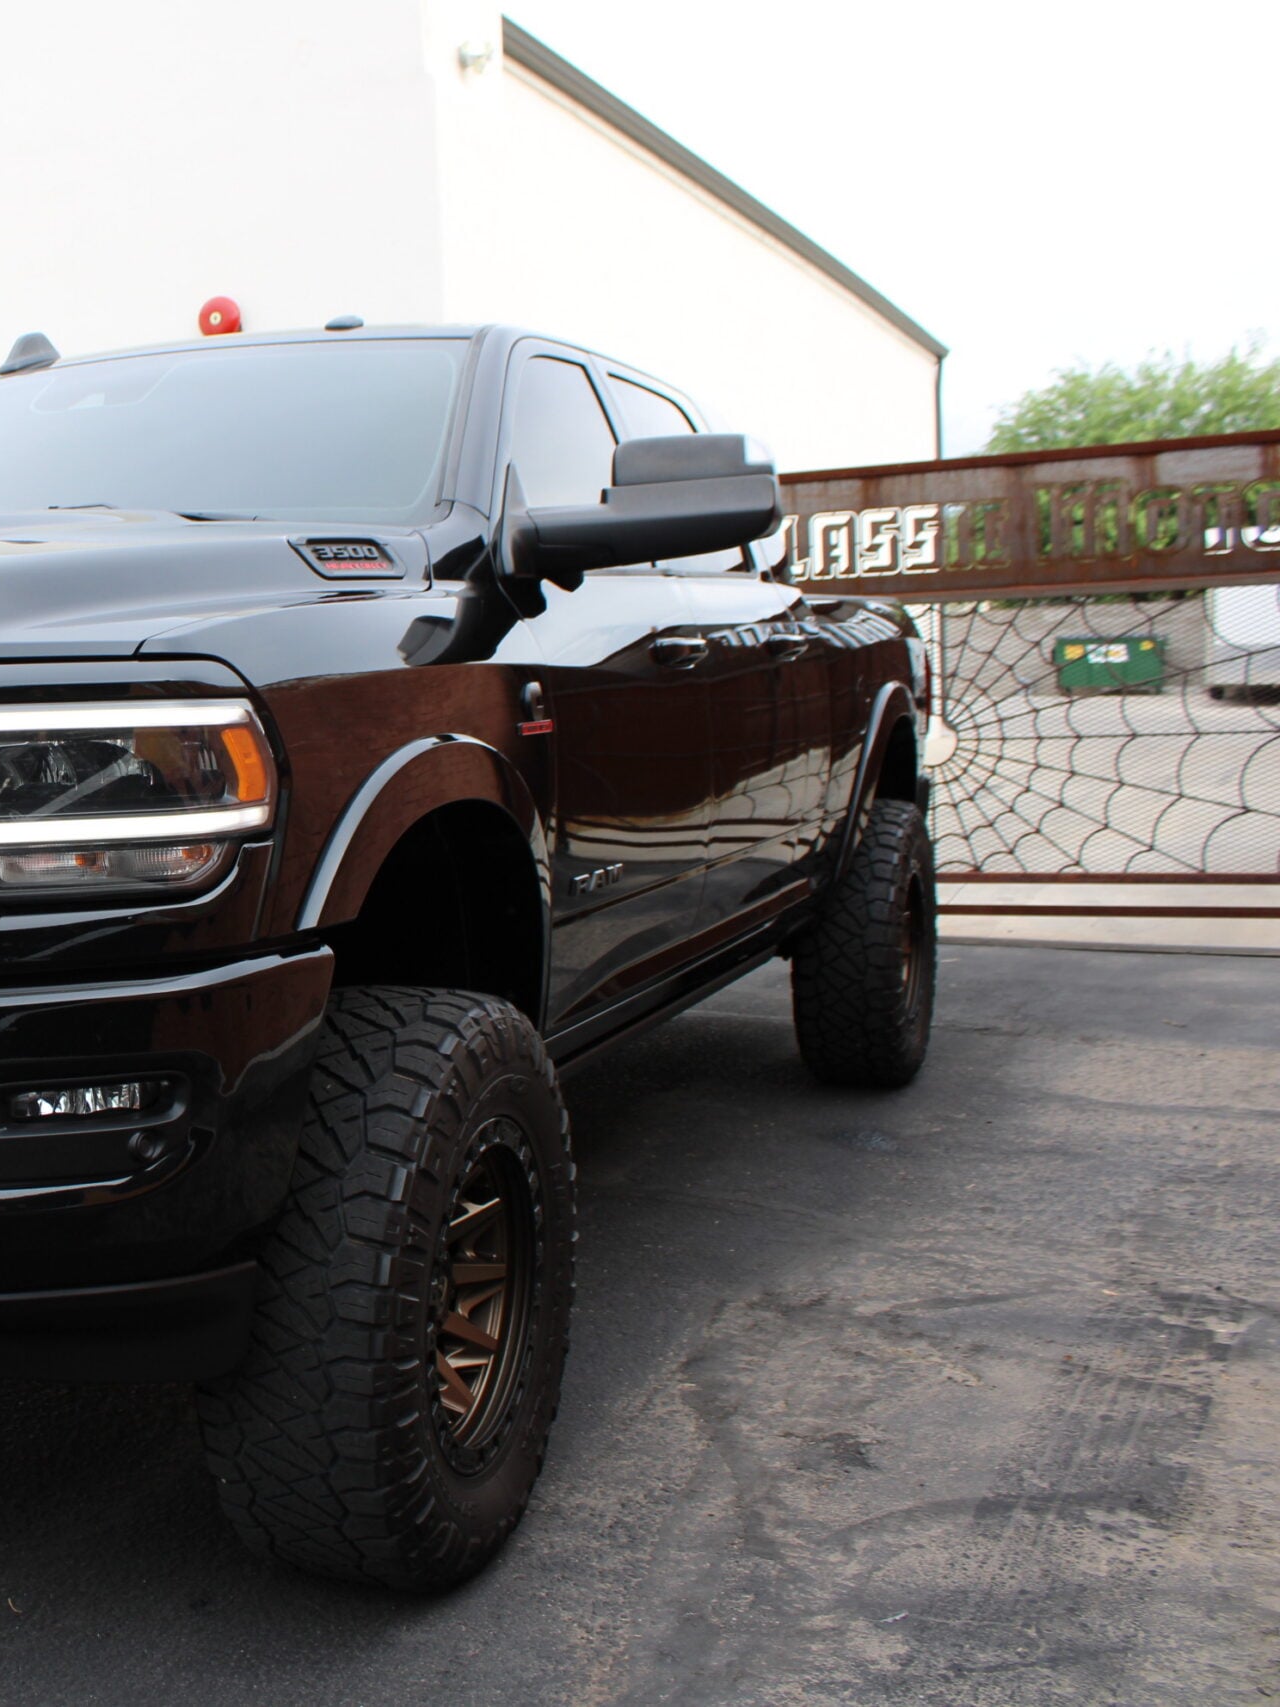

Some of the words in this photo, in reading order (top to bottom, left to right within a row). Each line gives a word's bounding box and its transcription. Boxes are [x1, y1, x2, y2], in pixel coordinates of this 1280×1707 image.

[312, 545, 379, 560] 3500
[781, 499, 1010, 582] LASSIC
[570, 862, 624, 896] RAM
